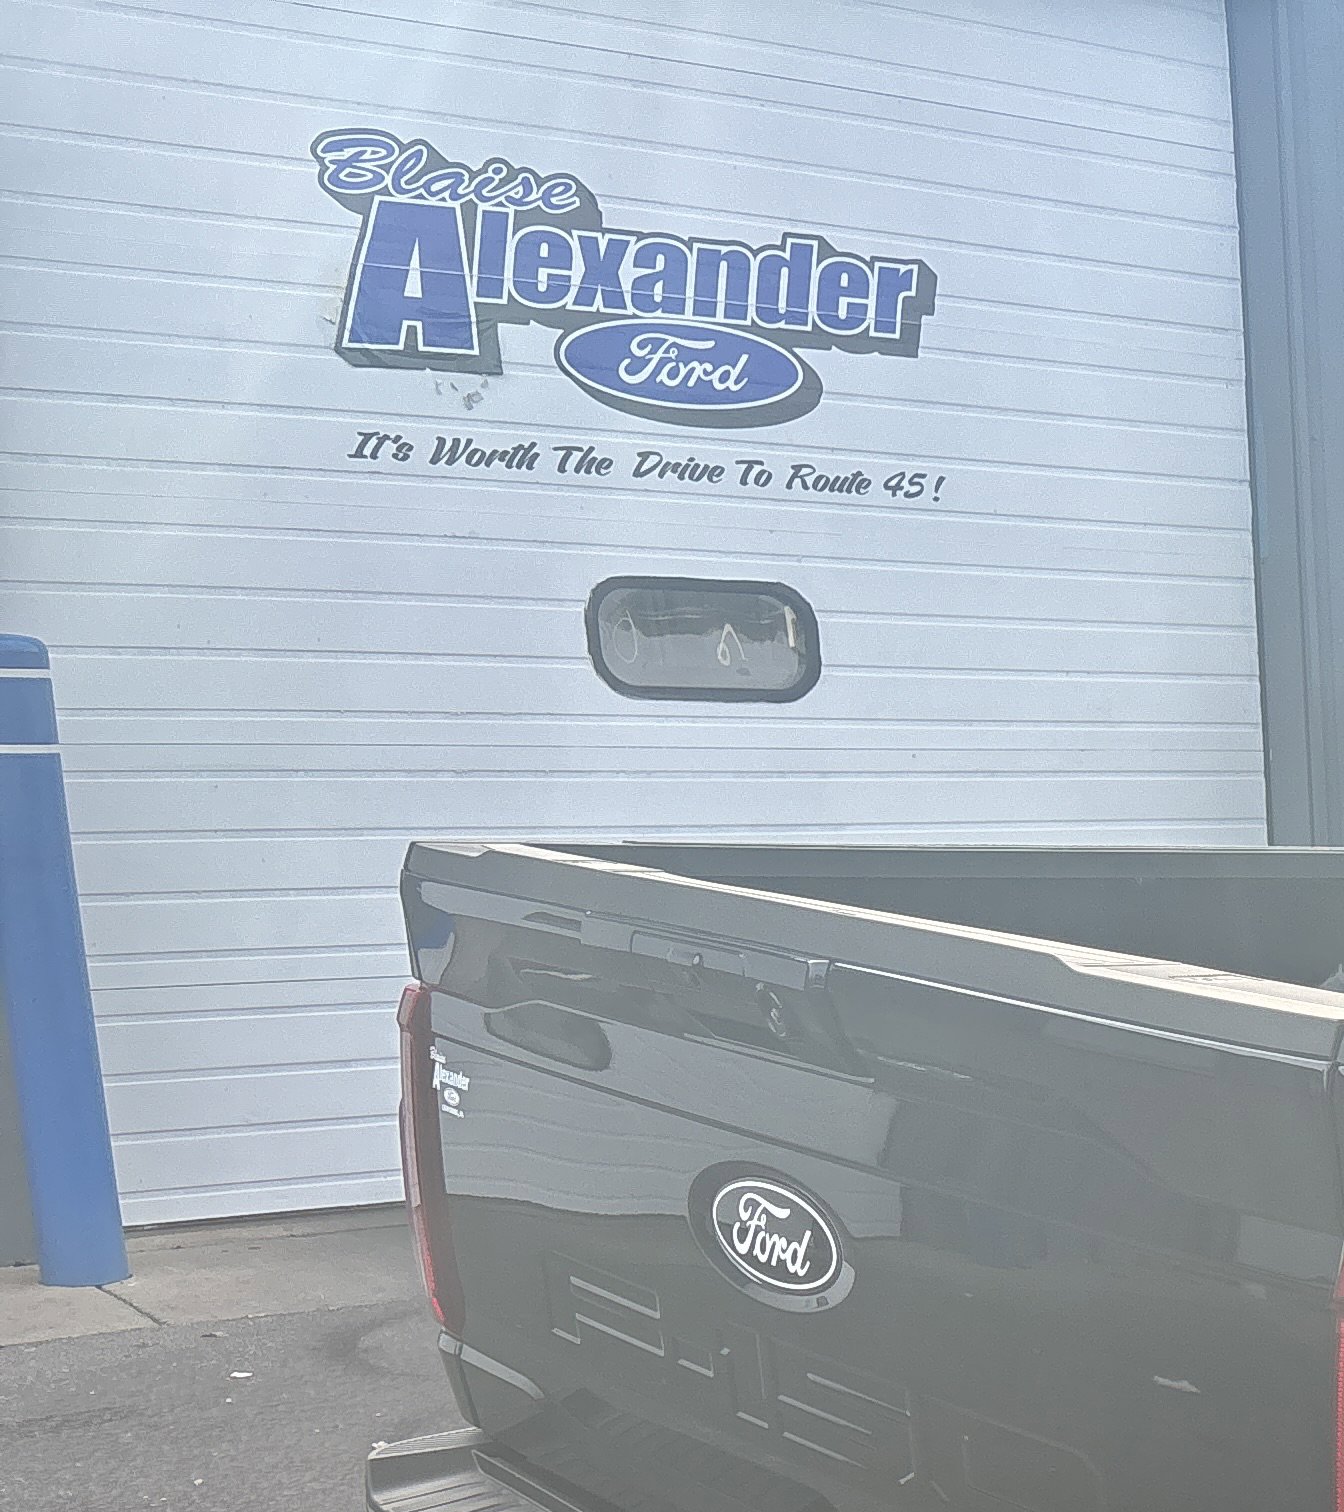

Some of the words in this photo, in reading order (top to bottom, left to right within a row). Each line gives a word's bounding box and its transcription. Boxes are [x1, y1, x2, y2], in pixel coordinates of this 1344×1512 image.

[316, 133, 580, 215] Blaise
[341, 195, 921, 355] Alexander
[617, 332, 750, 392] Ford
[347, 431, 414, 462] It's
[429, 436, 541, 471] Worth
[552, 445, 614, 476] The
[632, 451, 726, 484] Drive
[735, 460, 773, 487] To
[785, 464, 872, 495] Route
[732, 1192, 812, 1277] Ford
